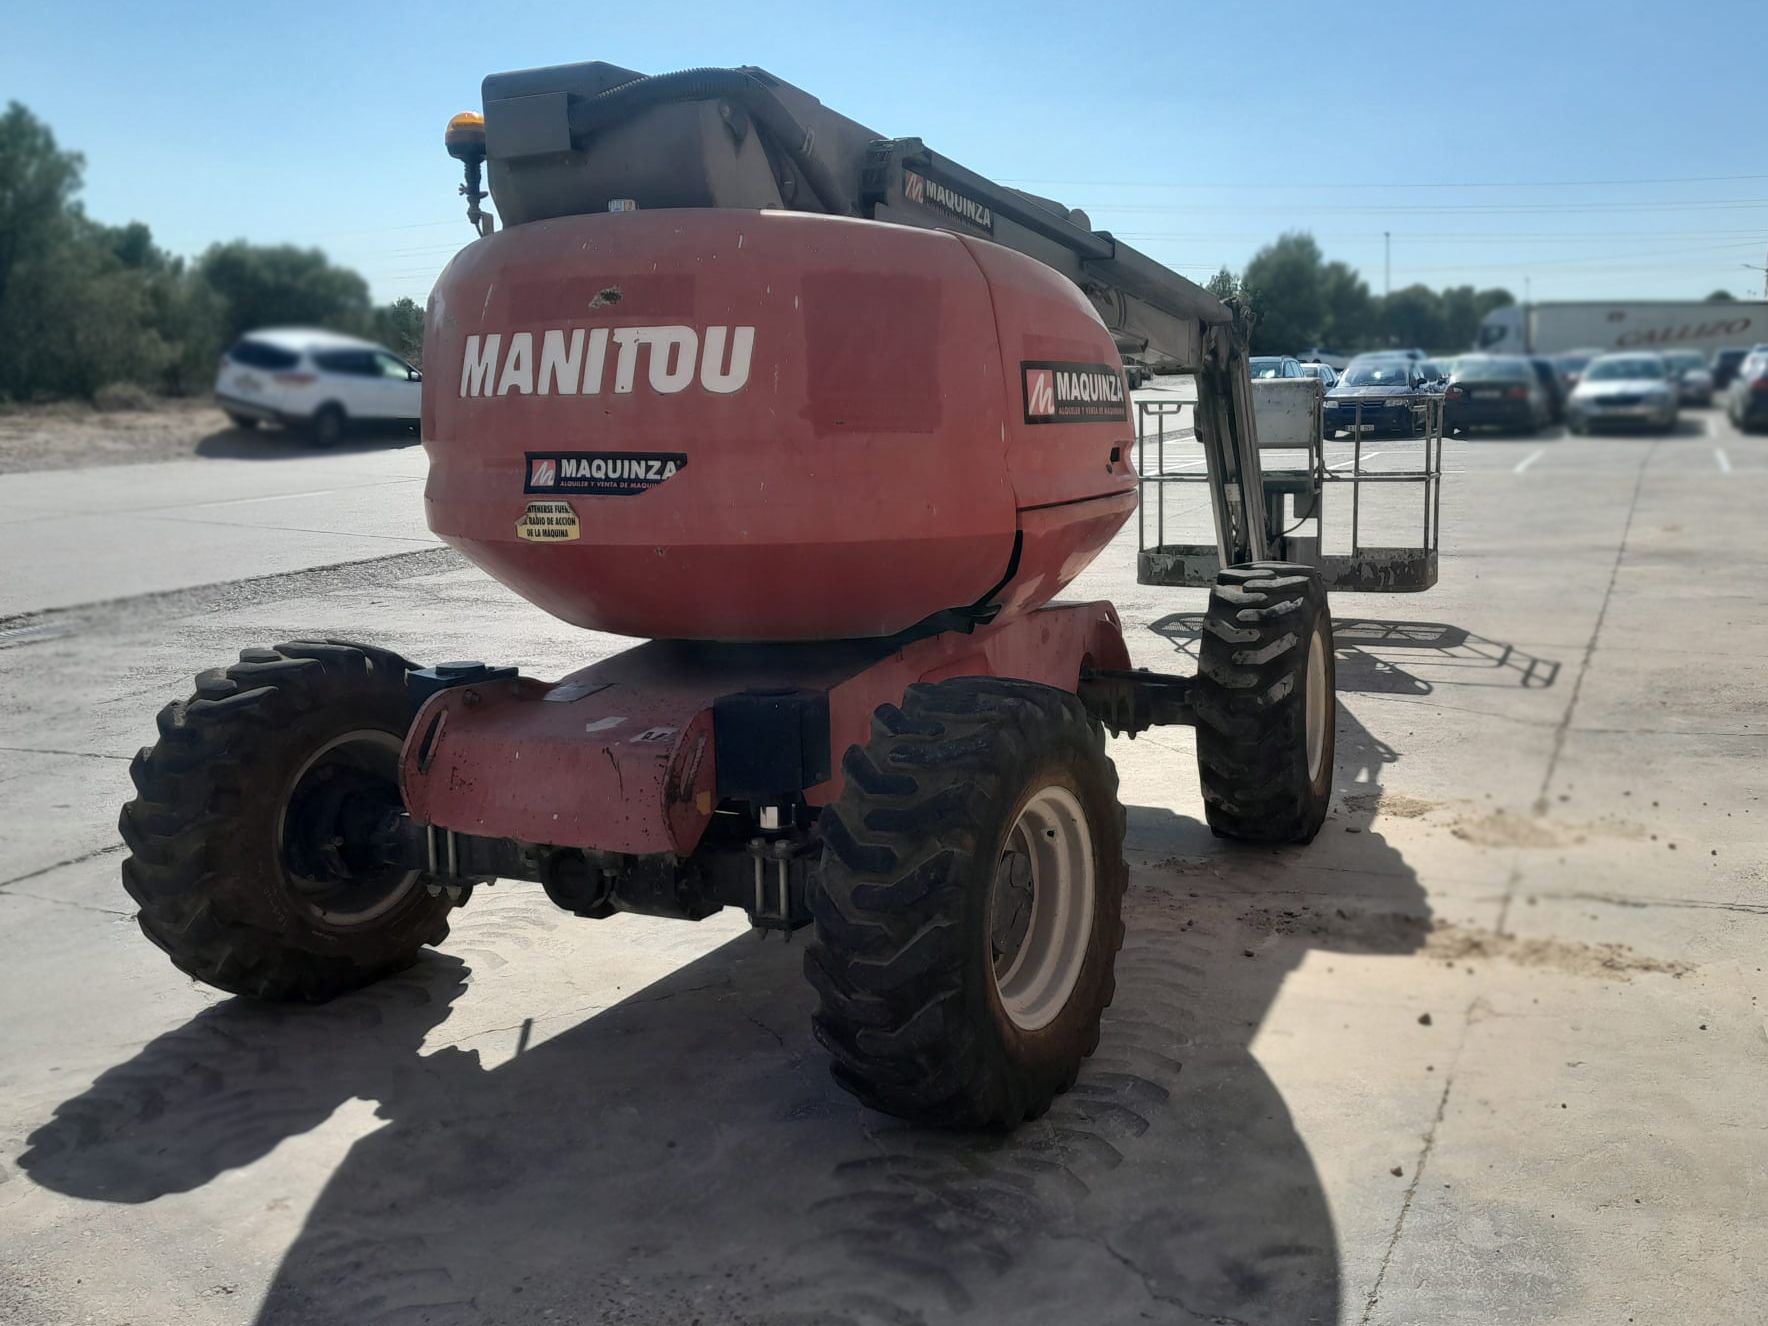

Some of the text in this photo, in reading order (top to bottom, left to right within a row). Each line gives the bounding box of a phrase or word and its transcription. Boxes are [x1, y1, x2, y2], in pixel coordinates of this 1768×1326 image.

[926, 179, 991, 228] MAQUINZA
[460, 325, 755, 398] MANITOU
[1056, 371, 1124, 402] MAQUINZA
[561, 459, 677, 480] MAQUINZA
[527, 529, 534, 537] DE
[535, 529, 541, 537] LA
[547, 517, 554, 525] DE
